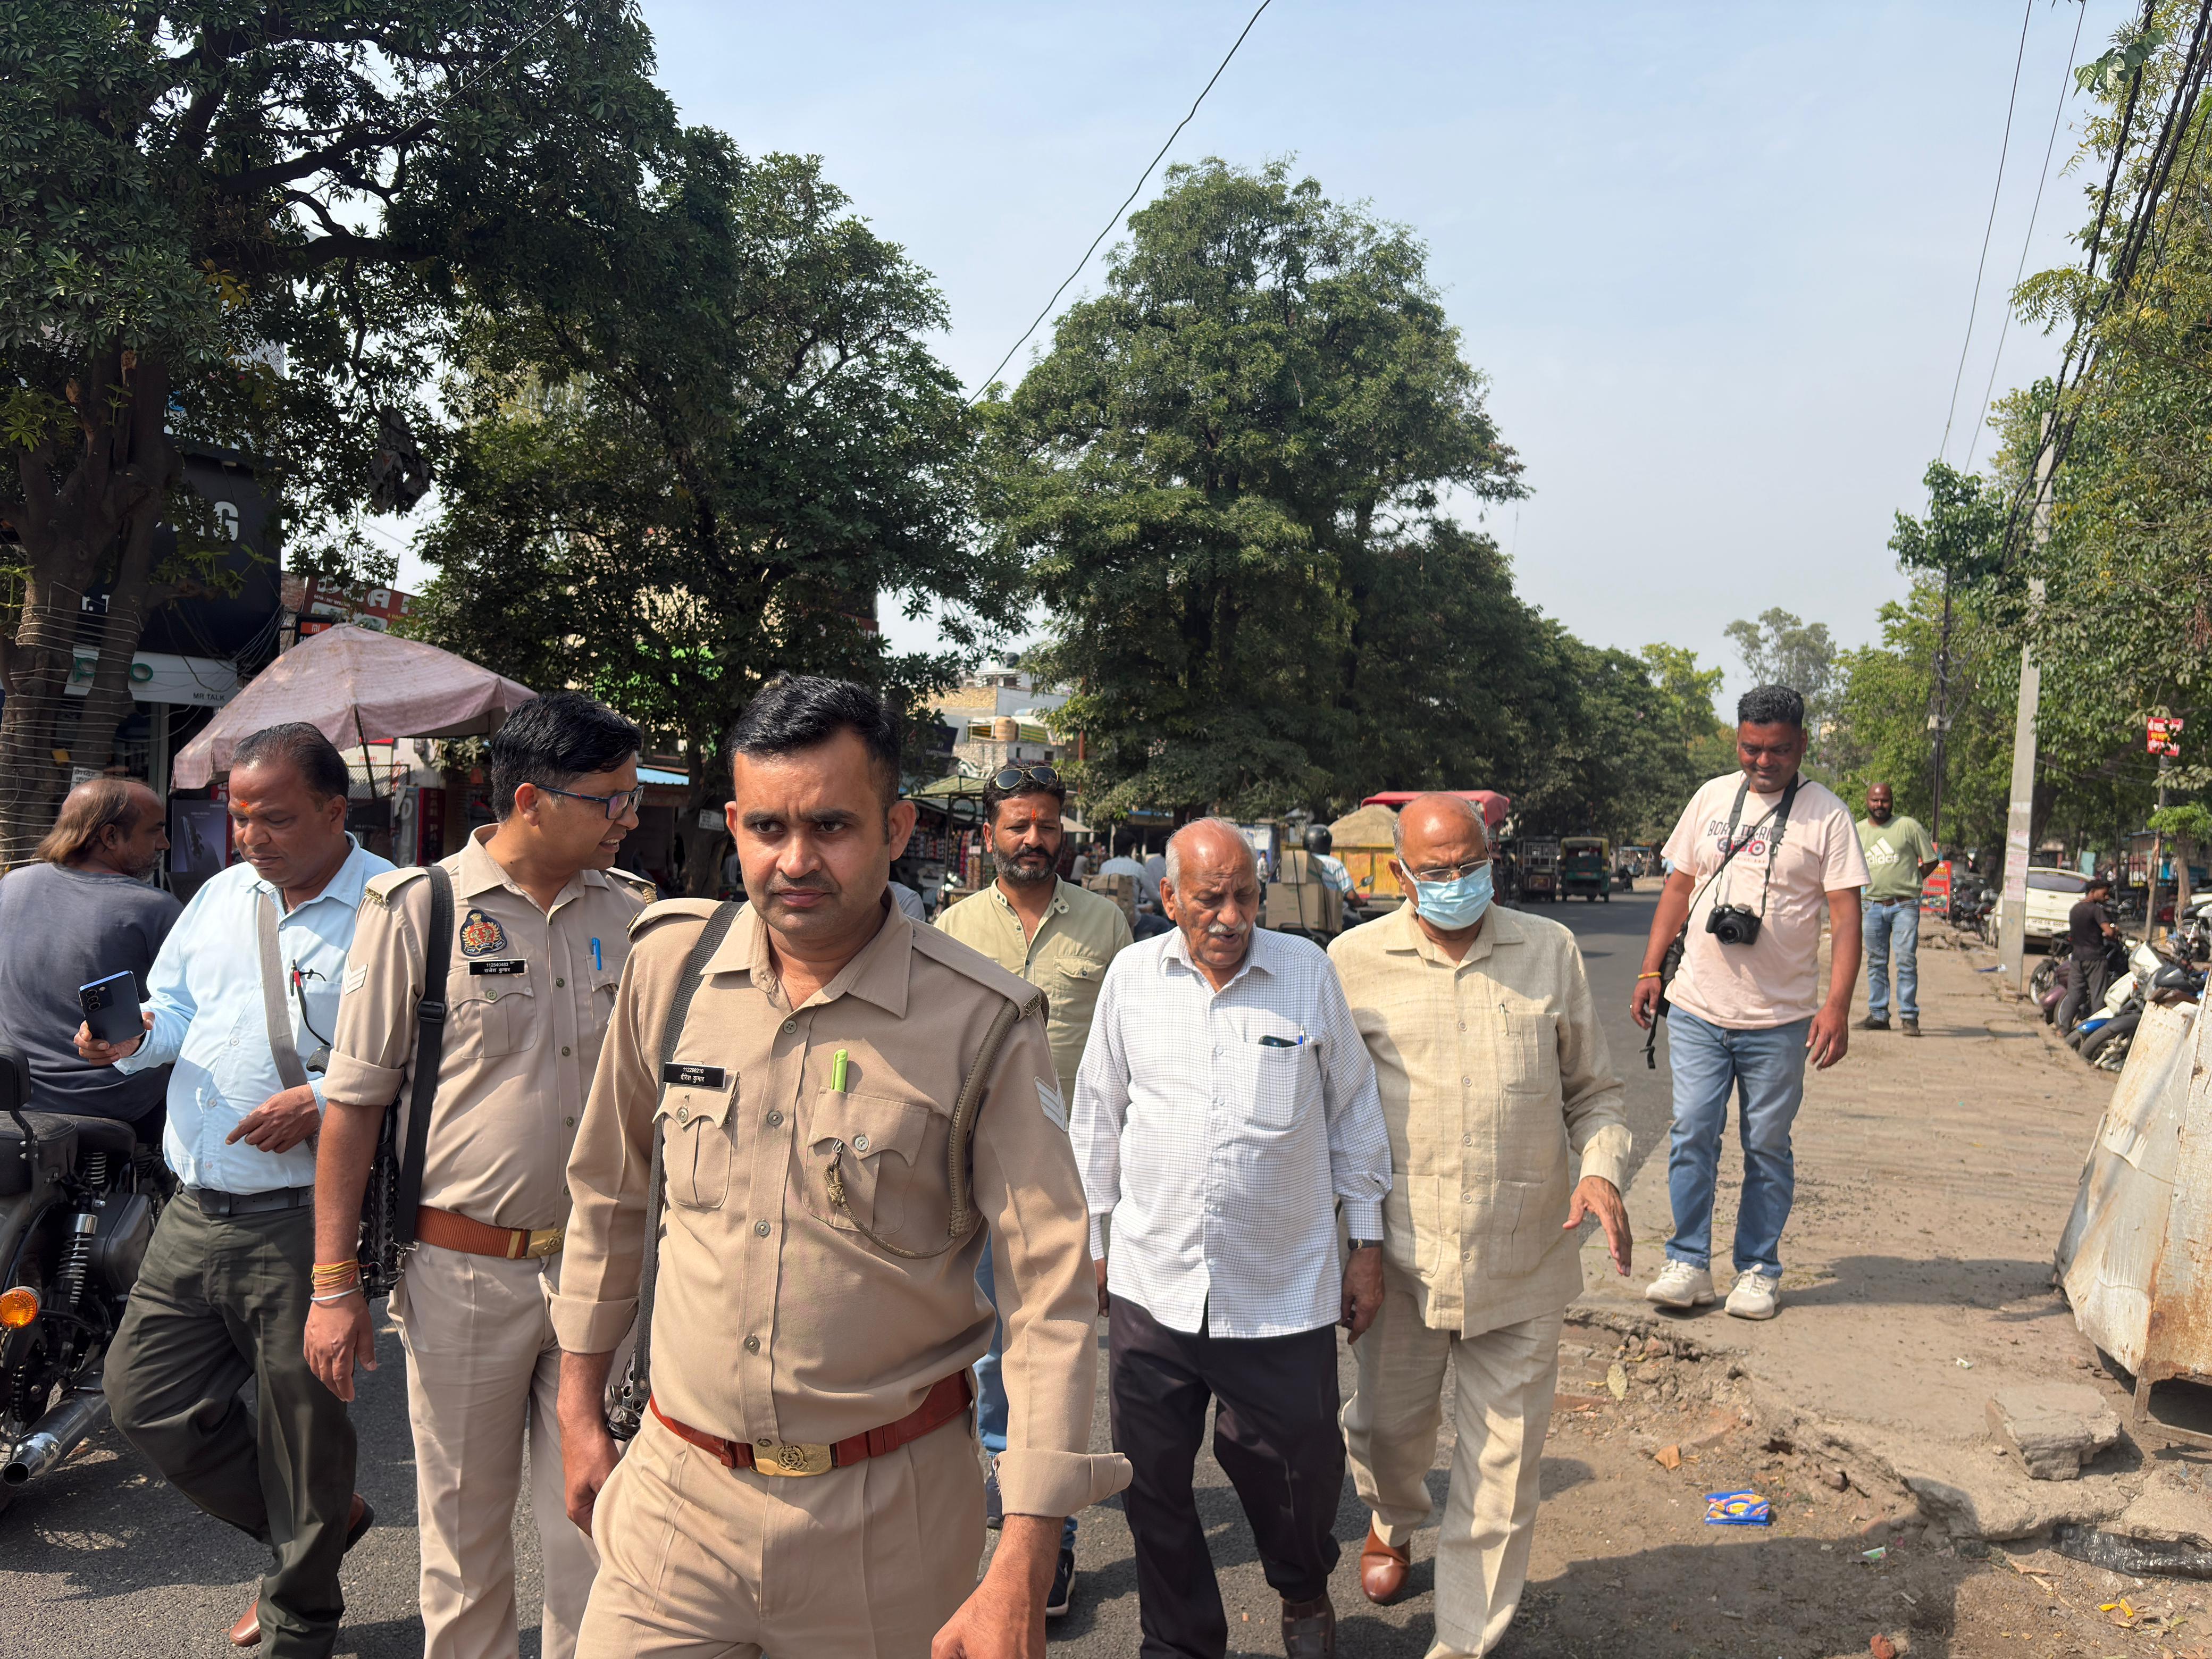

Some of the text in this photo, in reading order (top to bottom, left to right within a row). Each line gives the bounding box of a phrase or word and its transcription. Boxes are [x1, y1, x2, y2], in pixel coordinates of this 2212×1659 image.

[1707, 820, 1729, 836] BOR
[1865, 853, 1900, 867] didas
[680, 1073, 691, 1081] वीरेश
